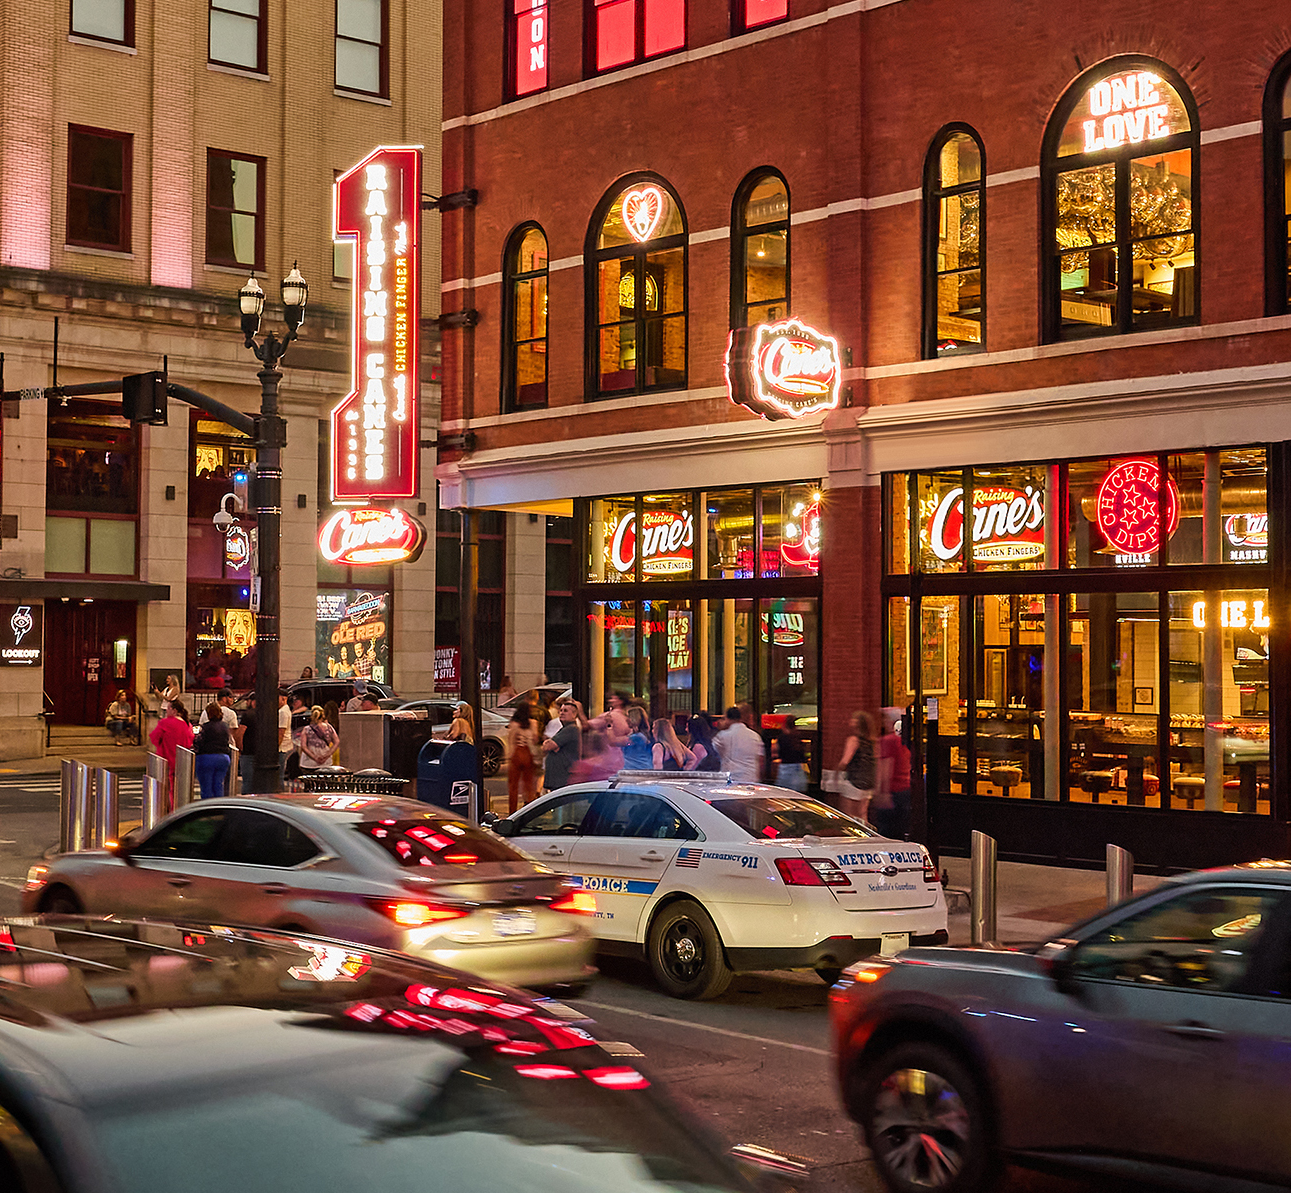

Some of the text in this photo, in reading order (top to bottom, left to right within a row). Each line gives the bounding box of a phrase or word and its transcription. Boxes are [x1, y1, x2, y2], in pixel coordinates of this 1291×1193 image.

[1090, 72, 1161, 116] ONE
[1083, 105, 1170, 153] LOVE
[363, 165, 388, 341] RAISING
[396, 258, 407, 308] FINGER
[395, 311, 407, 372] CHICKEN
[20, 389, 40, 400] PARKING
[363, 353, 386, 480] CANES
[973, 489, 1015, 504] Raising
[1102, 466, 1159, 527] CHICKEN
[642, 513, 674, 526] Raising
[320, 508, 409, 560] Cane's
[1008, 545, 1040, 556] FINGERS
[331, 621, 386, 646] OLE RED
[1, 649, 40, 658] LOOKOUT
[87, 673, 99, 682] OPEN
[439, 668, 456, 680] STYLE
[702, 852, 758, 869] EMERGENCY 911
[837, 852, 923, 866] METRO POLICE
[582, 876, 629, 893] POLICE
